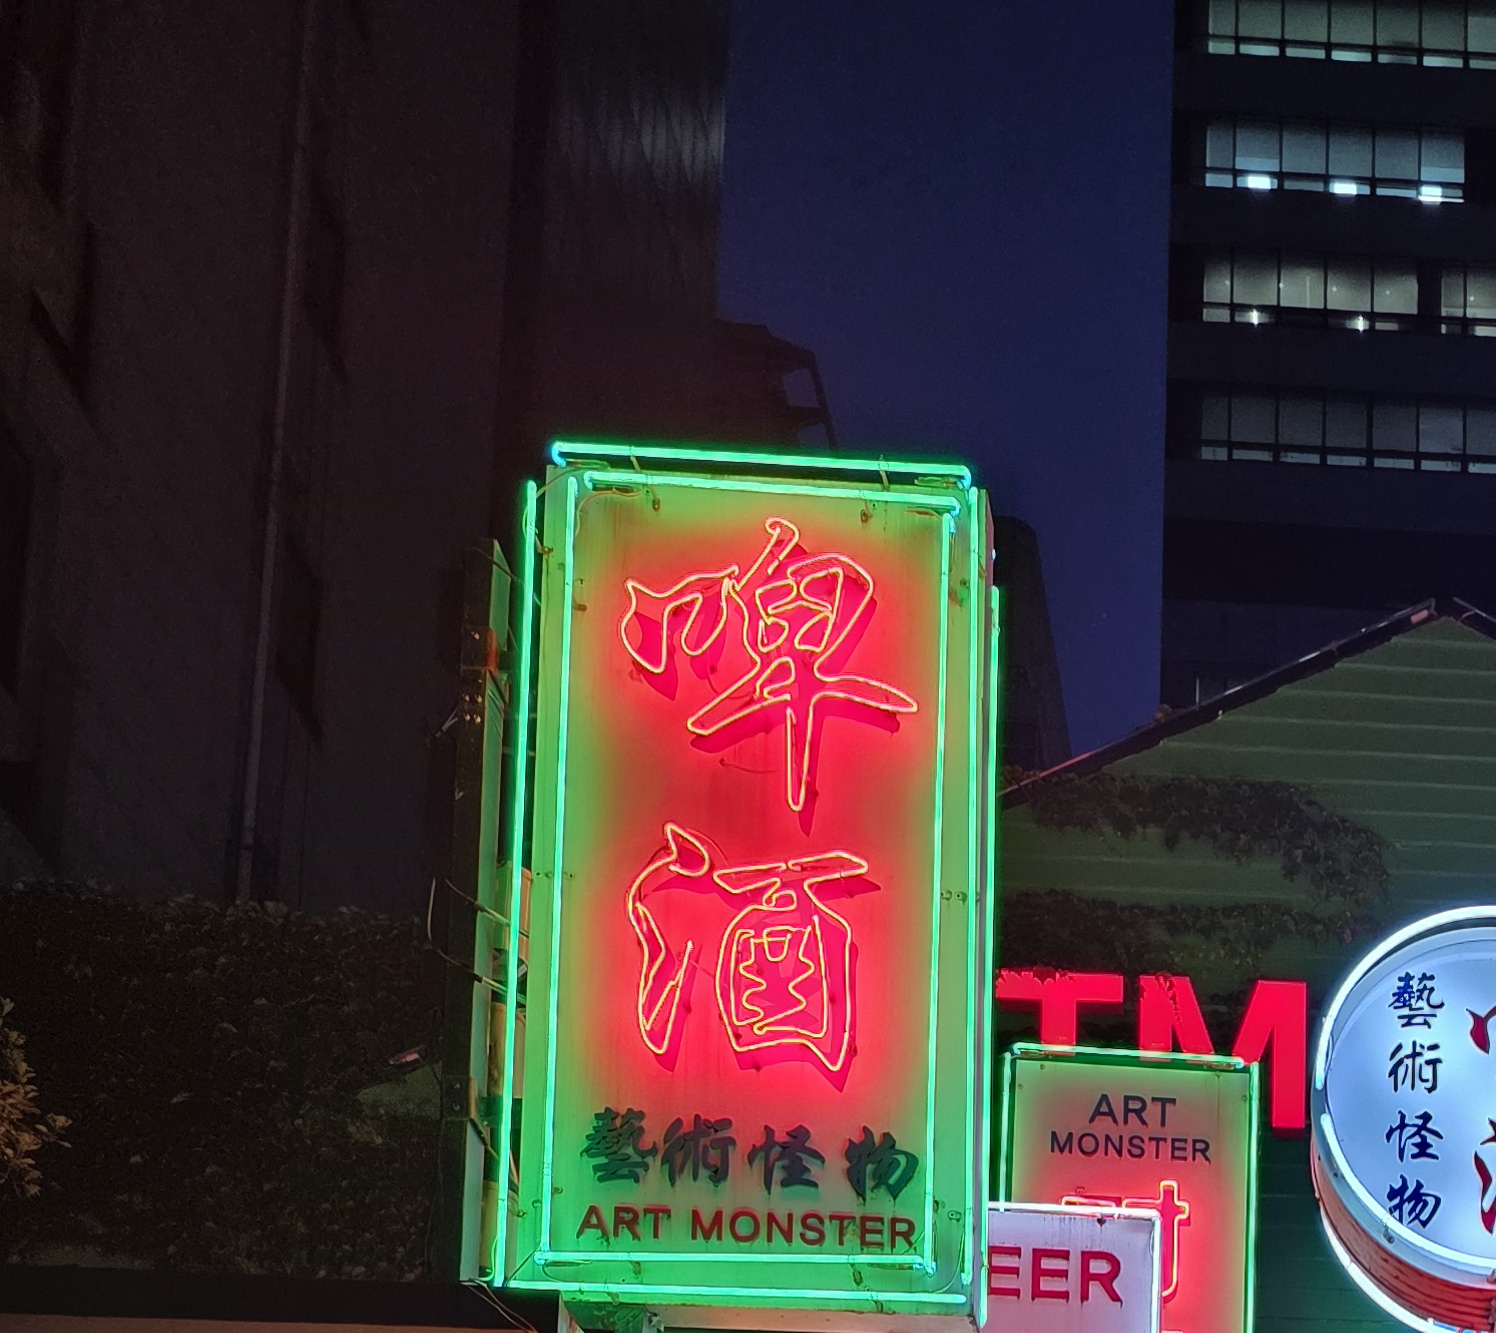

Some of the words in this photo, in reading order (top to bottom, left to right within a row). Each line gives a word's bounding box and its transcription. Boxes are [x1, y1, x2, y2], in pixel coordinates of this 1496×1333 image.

[620, 516, 918, 1071] 啤酒
[1089, 1093, 1176, 1127] ART
[1386, 972, 1444, 1228] 藝術怪物
[582, 1107, 919, 1199] 藝術怪物
[1050, 1130, 1211, 1163] MONSTER
[576, 1204, 671, 1240] ART
[691, 1207, 917, 1248] MONSTER
